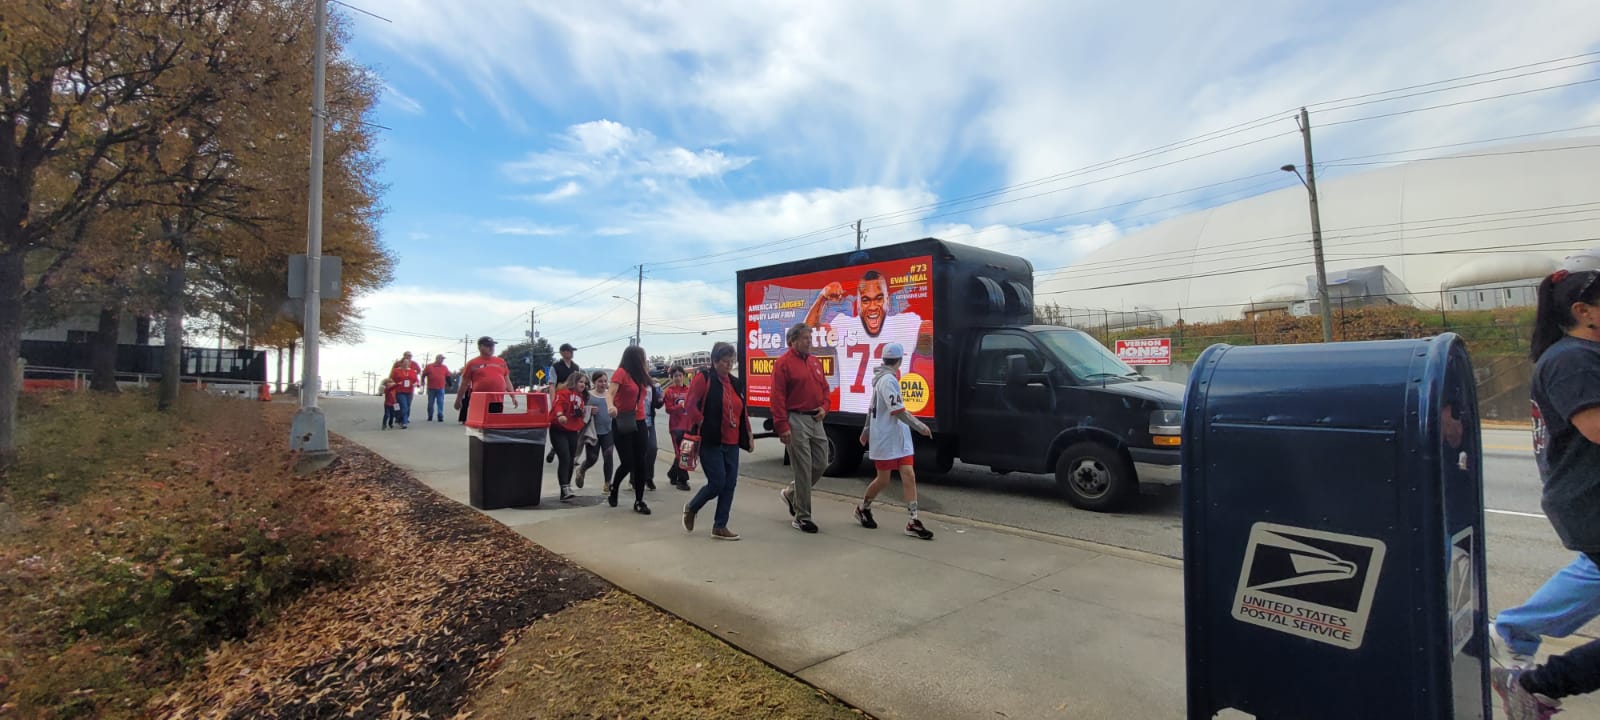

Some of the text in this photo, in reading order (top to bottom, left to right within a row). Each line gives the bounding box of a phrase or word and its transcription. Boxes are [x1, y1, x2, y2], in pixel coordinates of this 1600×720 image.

[911, 264, 927, 273] #73
[890, 273, 927, 285] EVAN NEAL
[748, 299, 805, 312] AMERICA'S LARGEST
[768, 312, 781, 320] LAW
[781, 310, 796, 318] FIRM
[749, 328, 781, 350] Size
[1118, 346, 1168, 358] JONES
[901, 381, 924, 390] DIAL
[889, 394, 901, 407] 24
[1243, 594, 1348, 627] UNITED STATES
[1240, 607, 1352, 642] POSTAL SERVICE
